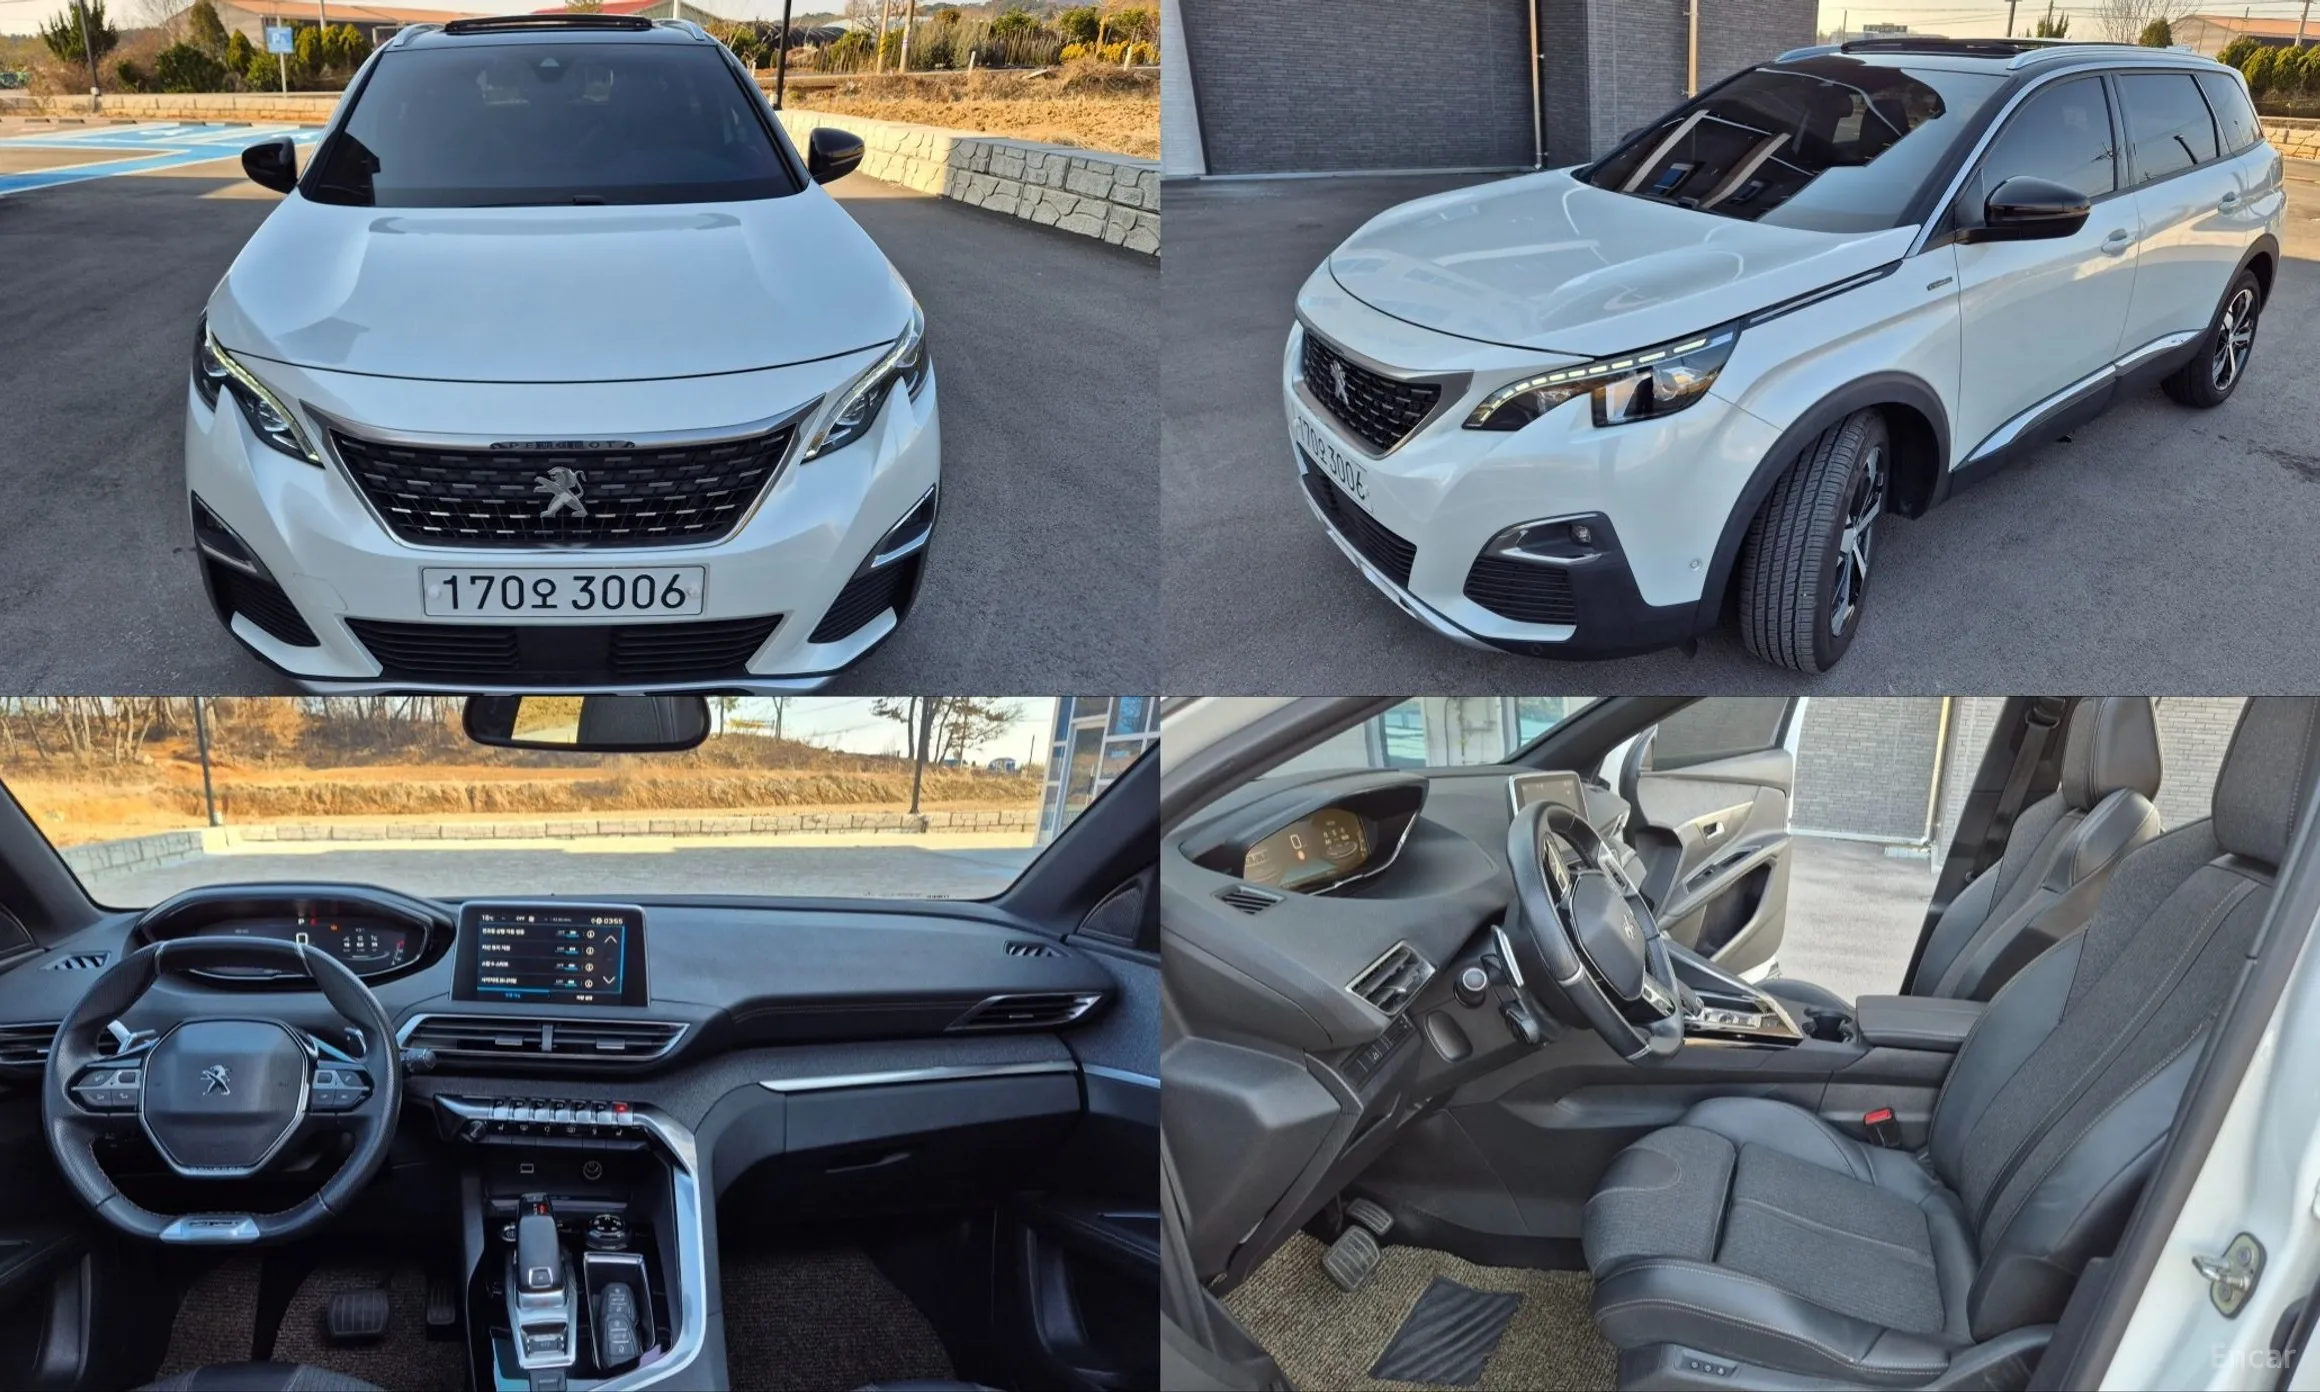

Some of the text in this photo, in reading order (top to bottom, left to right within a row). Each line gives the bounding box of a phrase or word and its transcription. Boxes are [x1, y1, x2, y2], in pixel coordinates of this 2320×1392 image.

[1327, 445, 1366, 500] 3006
[443, 574, 686, 610] 170오 3006
